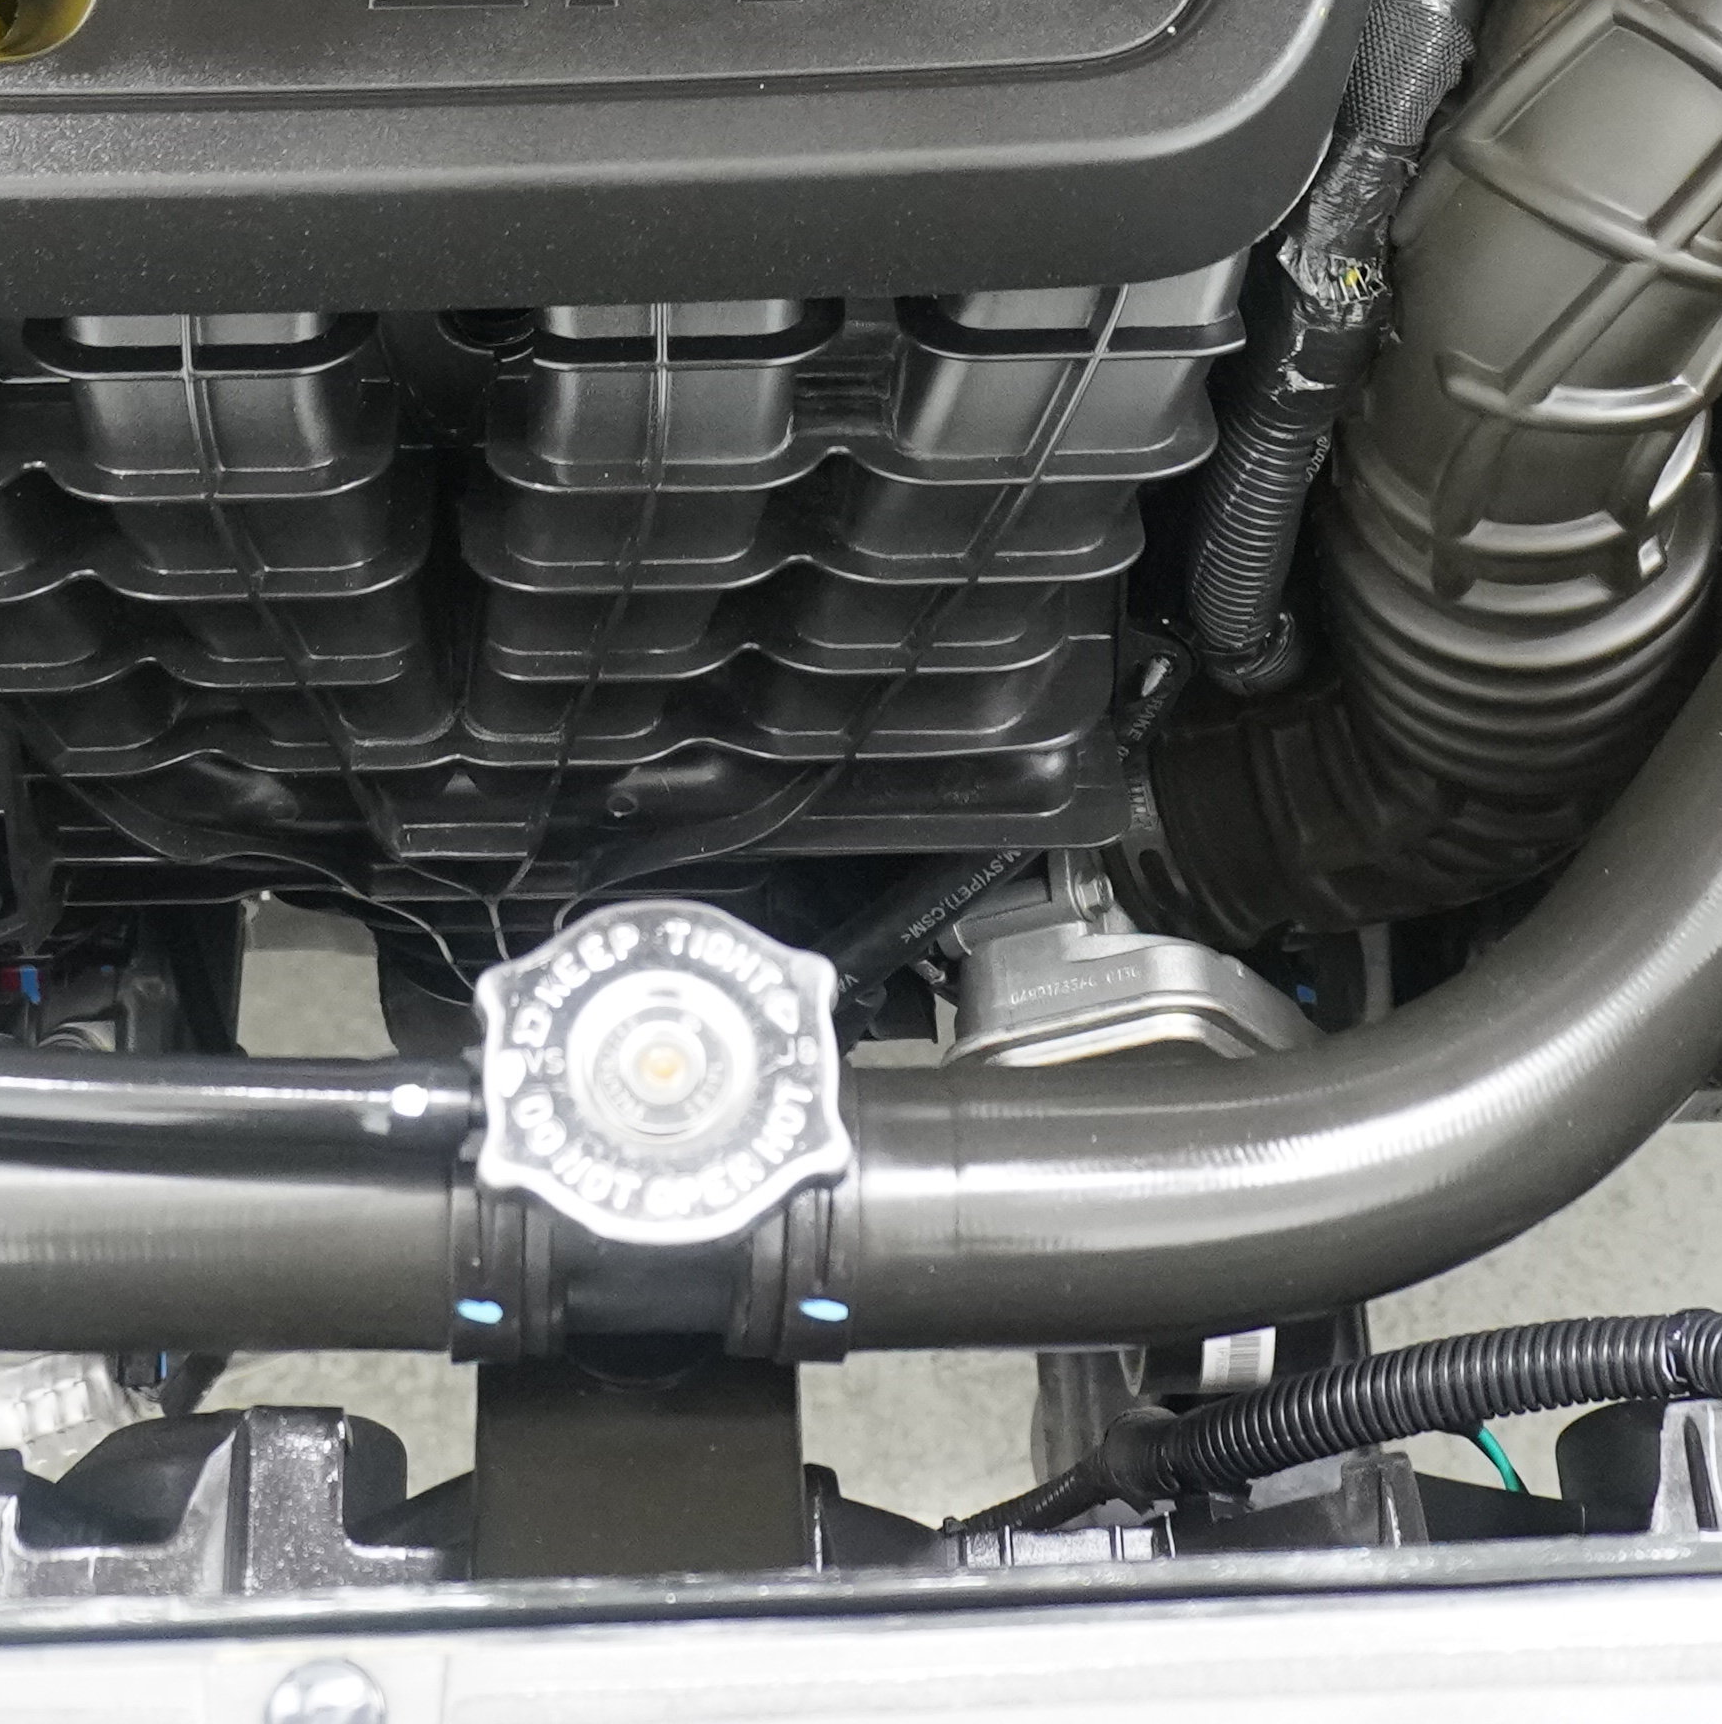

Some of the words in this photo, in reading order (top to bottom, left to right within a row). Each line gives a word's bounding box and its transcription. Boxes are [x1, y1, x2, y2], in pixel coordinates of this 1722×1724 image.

[533, 921, 641, 1009] KEEP
[664, 916, 784, 995] TIGHT
[512, 1090, 568, 1157] DO
[551, 1146, 643, 1210] NOT
[644, 1149, 766, 1216] OPEN
[751, 1077, 813, 1165] HOT
